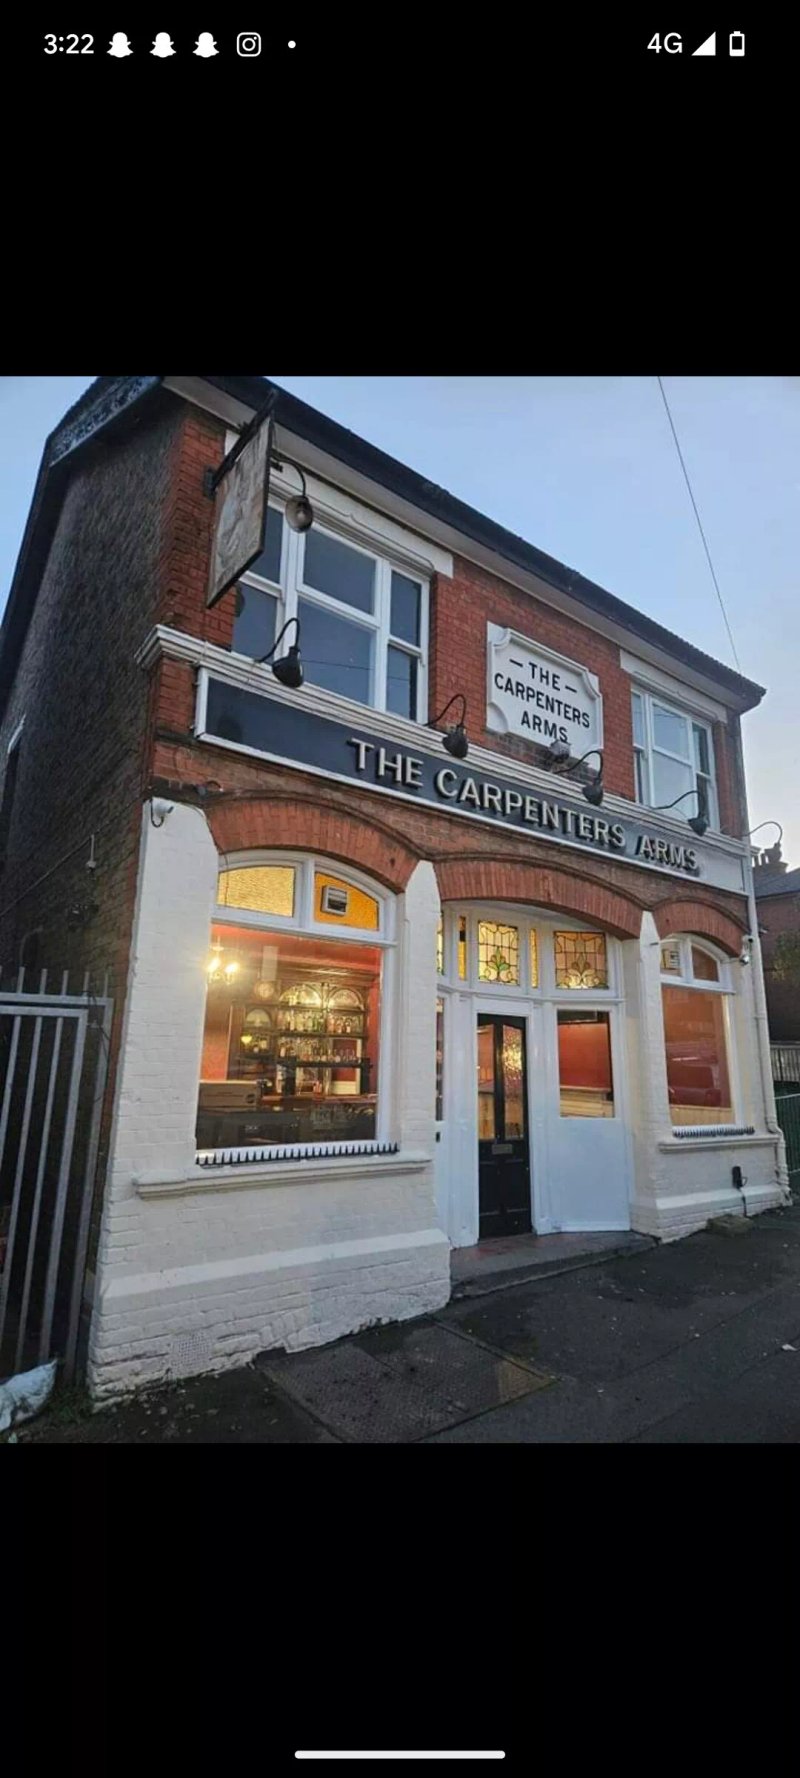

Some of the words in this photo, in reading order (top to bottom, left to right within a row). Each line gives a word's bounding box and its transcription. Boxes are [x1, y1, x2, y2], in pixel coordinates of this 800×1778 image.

[528, 661, 561, 691] THE
[494, 673, 590, 729] CARPENTERS
[521, 710, 568, 743] ARMS
[349, 737, 424, 787] THE
[435, 768, 627, 848] CARPENTERS
[637, 834, 700, 871] ARMS
